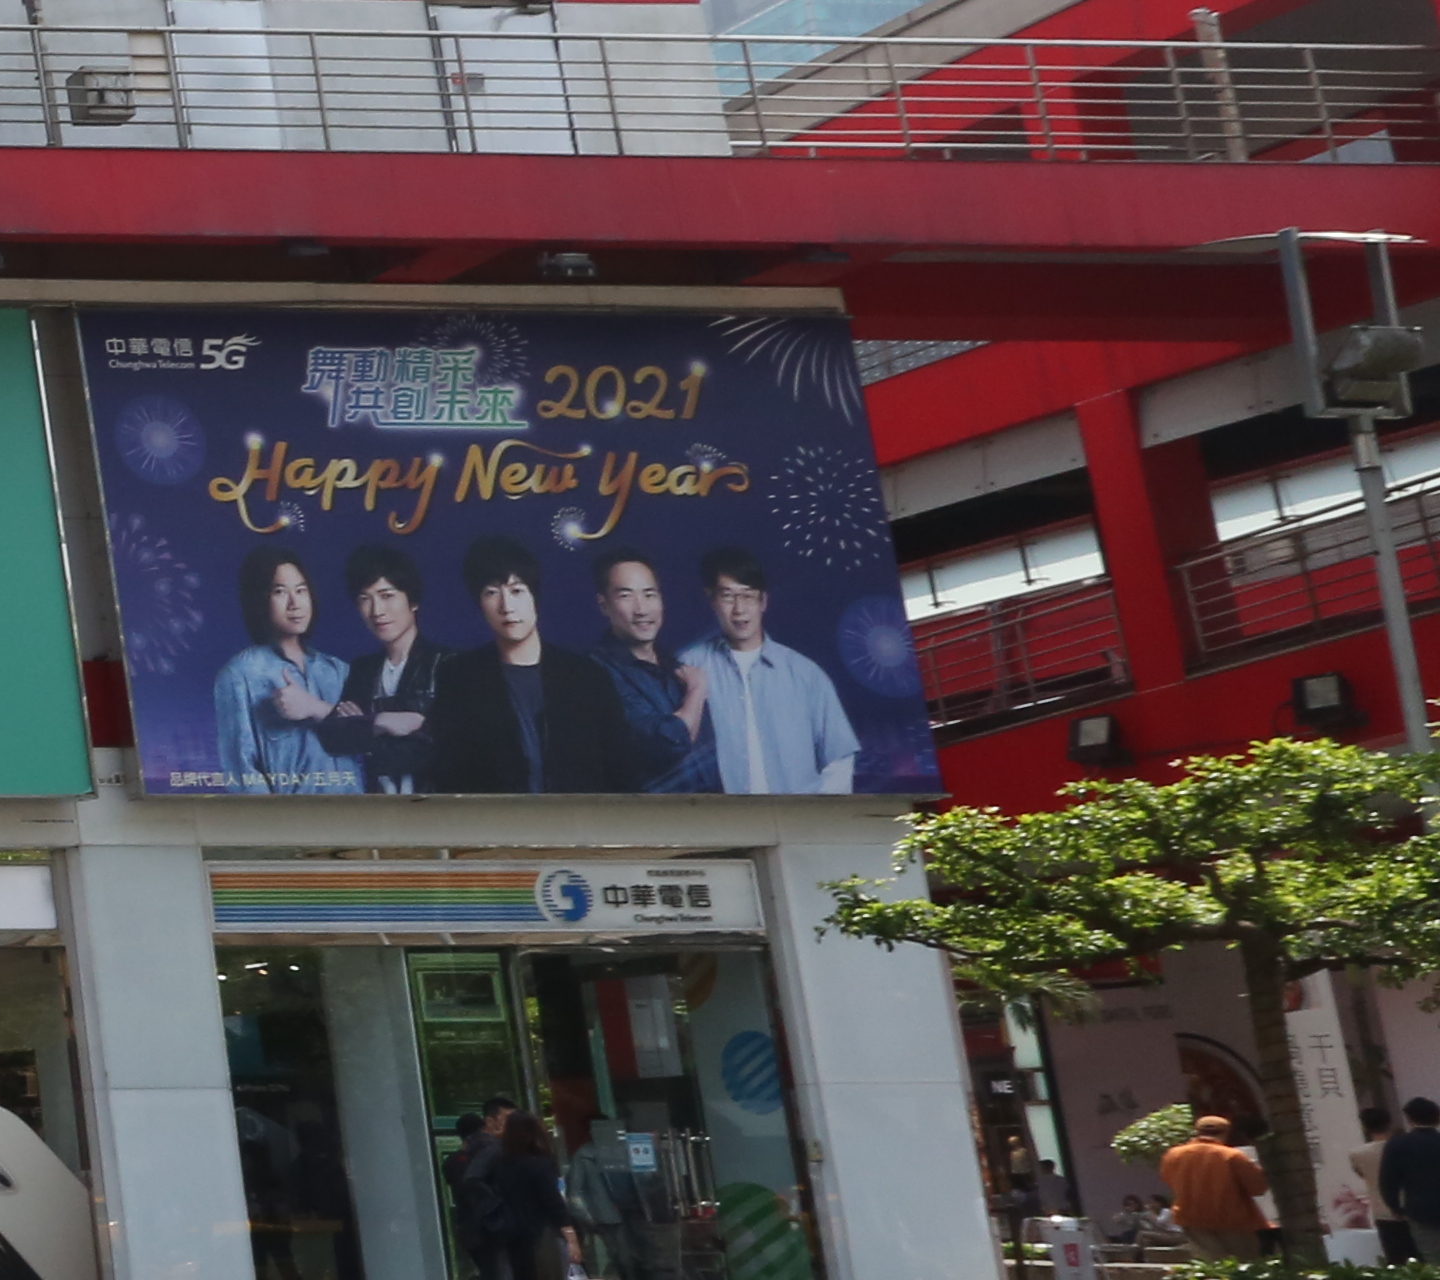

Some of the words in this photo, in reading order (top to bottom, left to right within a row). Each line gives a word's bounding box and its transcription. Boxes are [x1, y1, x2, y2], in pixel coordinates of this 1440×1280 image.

[104, 337, 194, 358] 中華電信
[199, 333, 263, 371] 5G
[108, 358, 157, 372] Chunghwa
[158, 358, 196, 370] Telecom
[536, 362, 708, 422] 2021
[208, 440, 441, 535] Happy
[455, 438, 592, 503] New
[573, 451, 750, 540] Year
[169, 769, 238, 789] 品牌代言人
[242, 772, 310, 788] MAYDAY
[312, 771, 356, 788] 五月天
[602, 883, 712, 909] 中華電信
